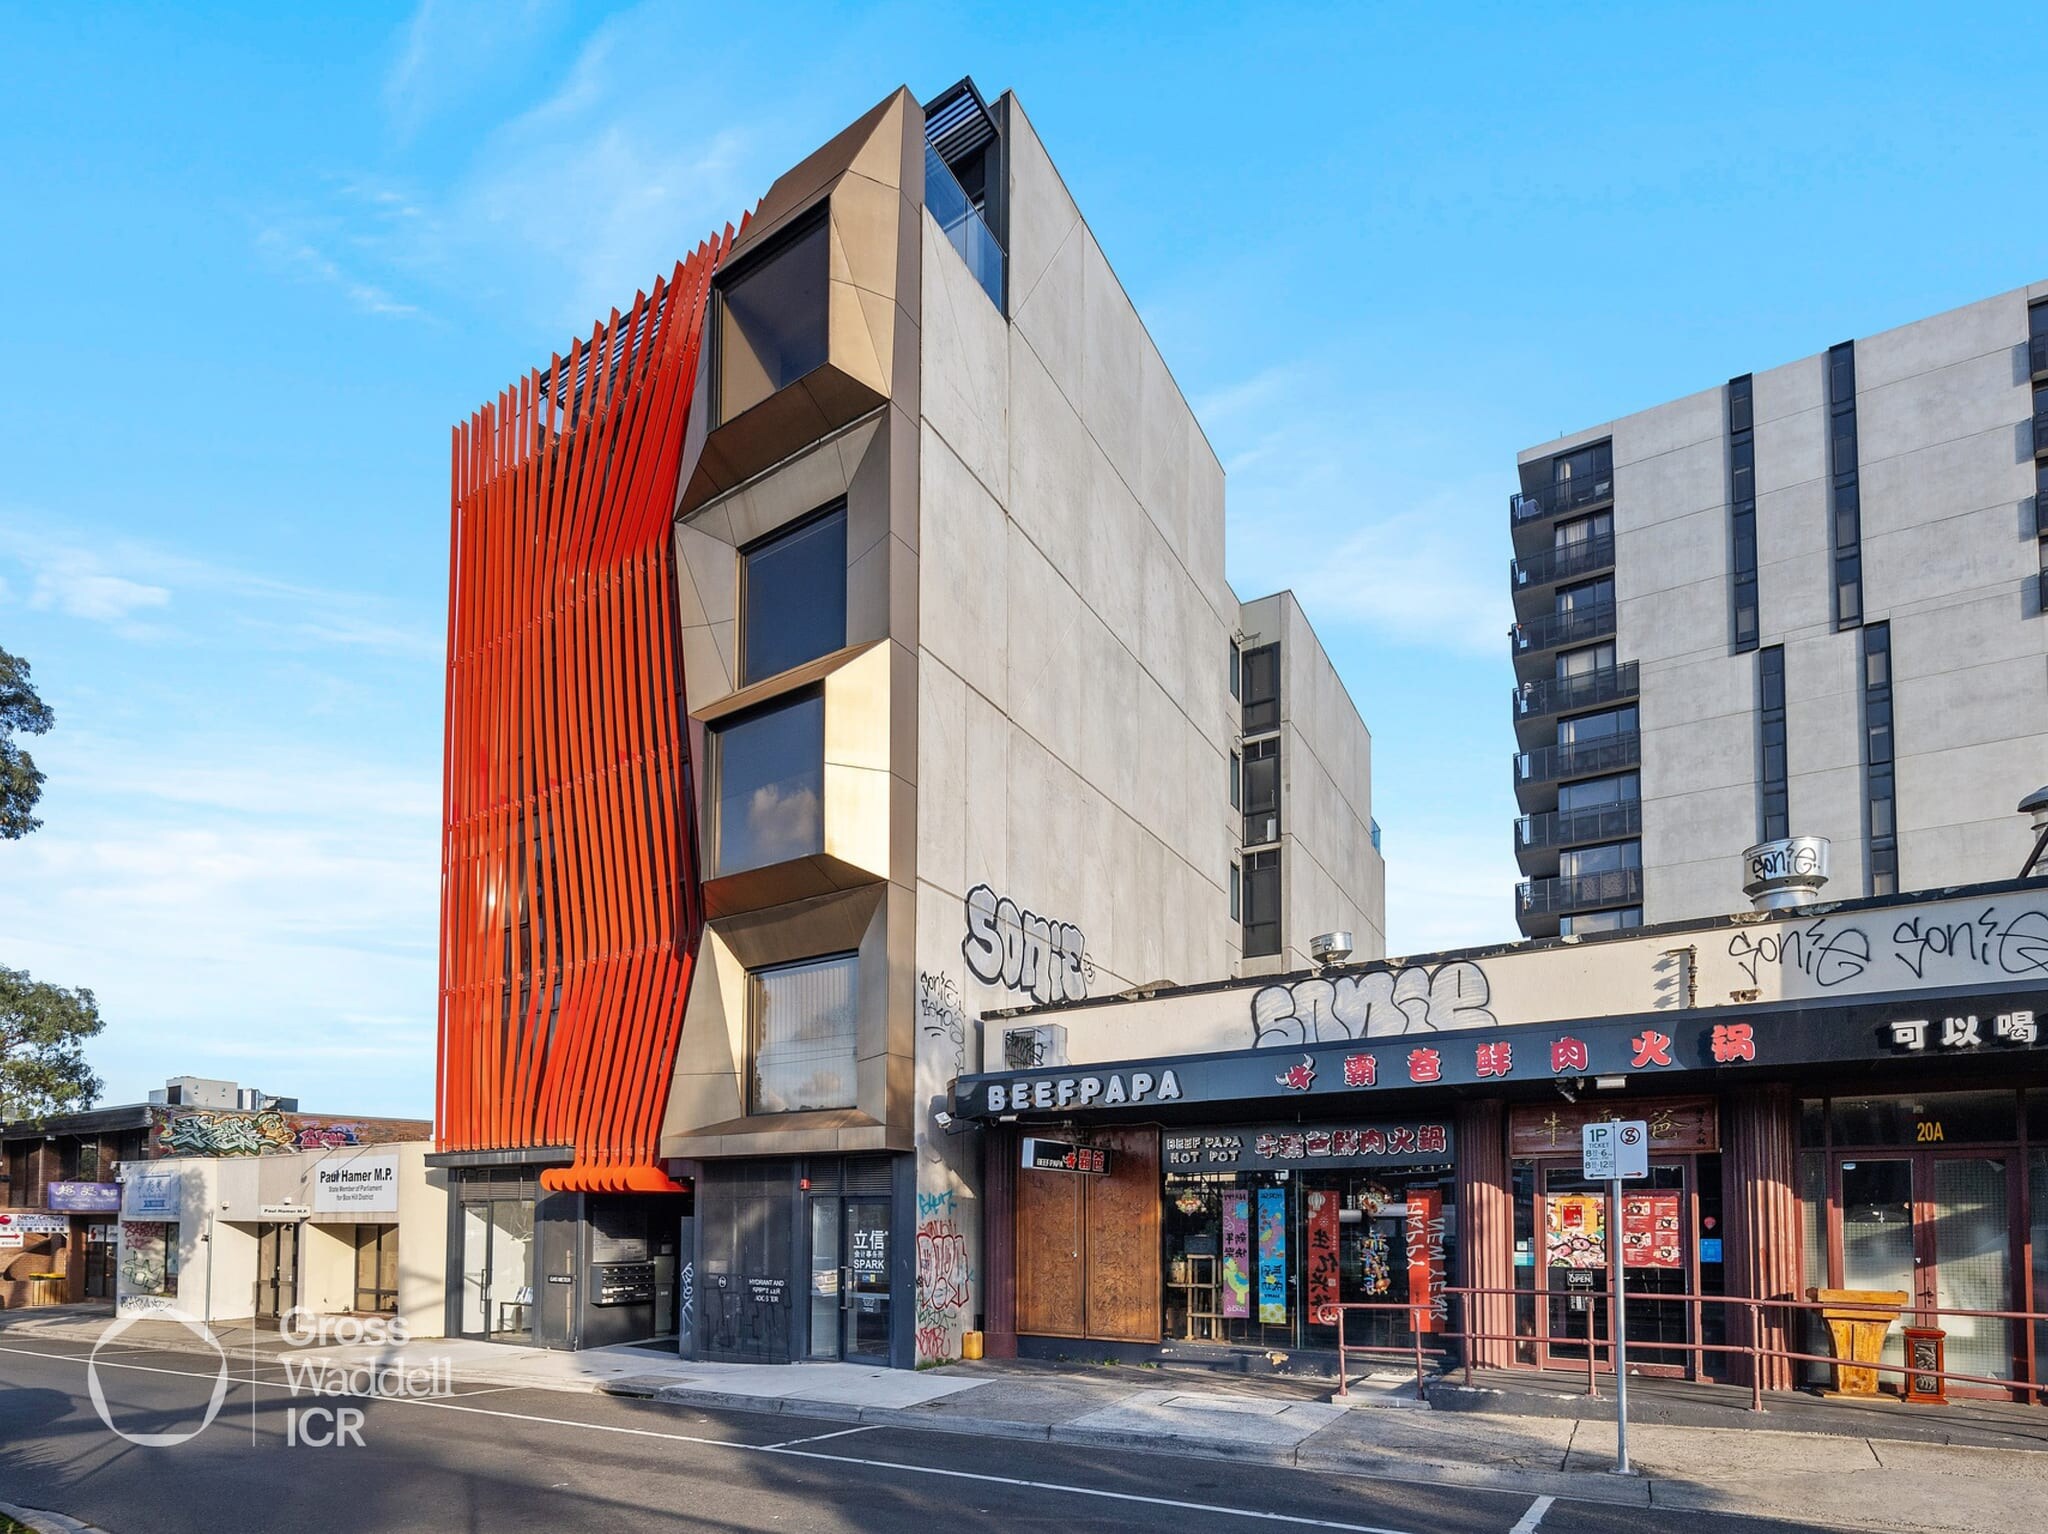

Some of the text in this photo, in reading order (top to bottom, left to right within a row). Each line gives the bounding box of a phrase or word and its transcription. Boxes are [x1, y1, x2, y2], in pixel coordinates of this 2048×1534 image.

[1891, 1010, 2038, 1050] 可以喝
[987, 1070, 1182, 1112] BEEFPAPA
[1589, 1128, 1608, 1142] 1P
[1917, 1121, 1944, 1142] 20A
[1167, 1135, 1242, 1150] BEEF PAPA
[1170, 1150, 1239, 1164] HOT POT
[319, 1168, 393, 1183] Paul Hamer M.P.
[853, 1229, 885, 1250] 立信
[853, 1259, 885, 1270] SPARK
[1569, 1275, 1591, 1283] OPEN
